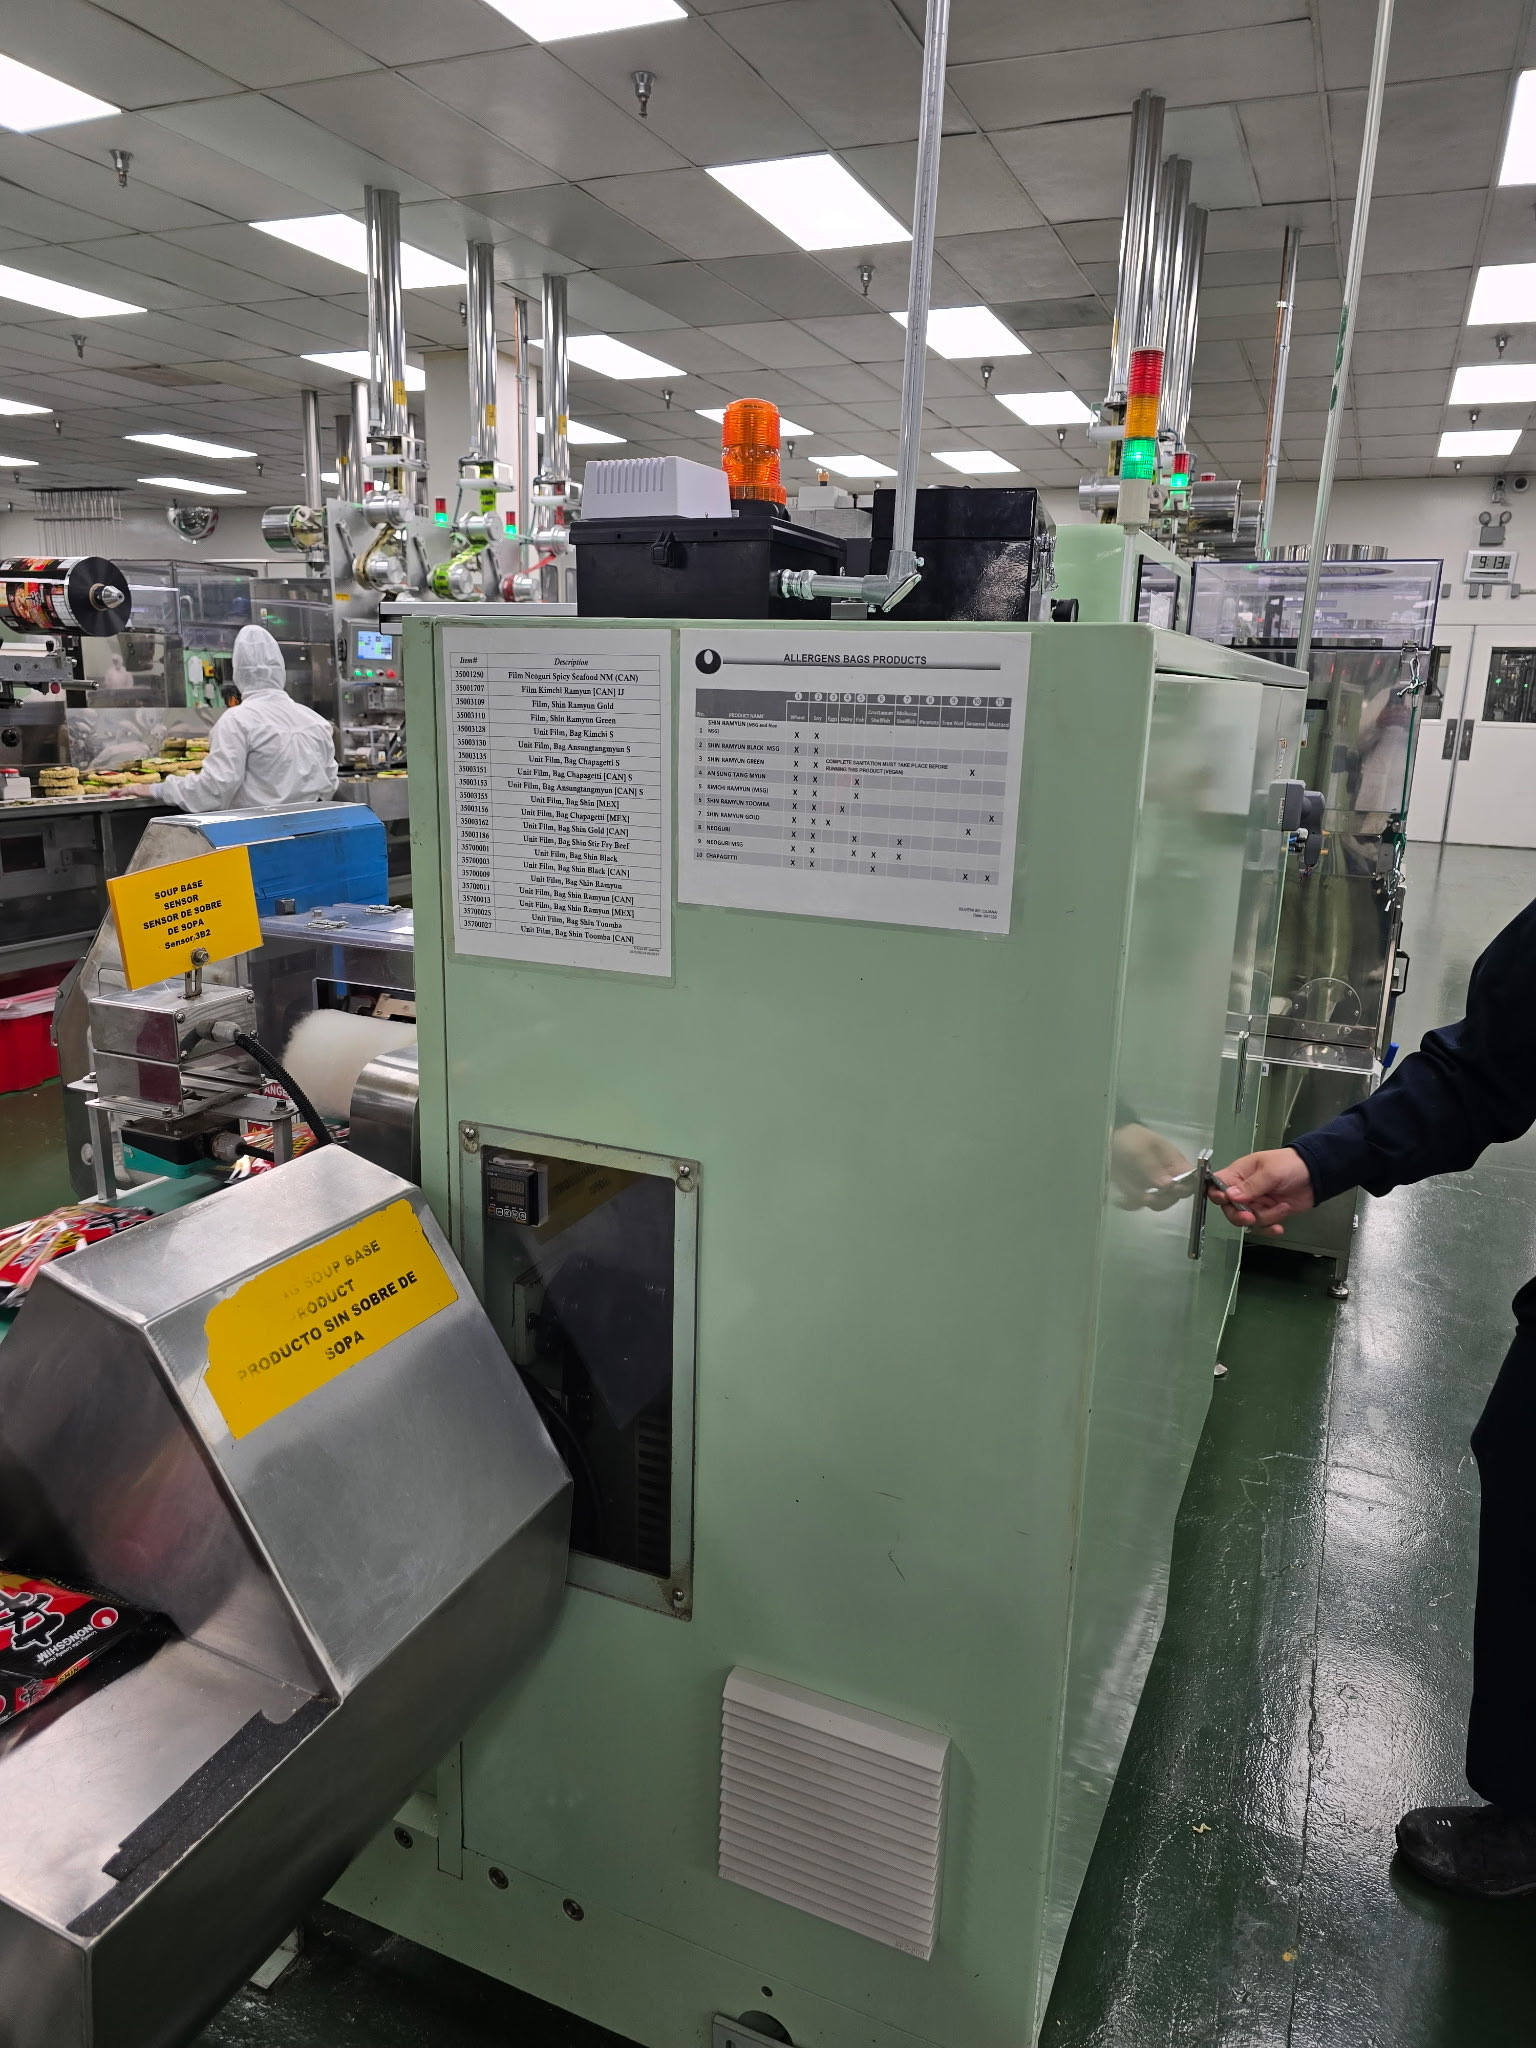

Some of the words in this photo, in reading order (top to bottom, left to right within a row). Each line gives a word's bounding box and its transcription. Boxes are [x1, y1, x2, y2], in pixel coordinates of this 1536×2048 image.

[1479, 556, 1505, 569] 9:13
[554, 658, 589, 668] Description
[784, 654, 840, 664] ALLERGENS
[843, 655, 870, 664] BAGS
[873, 656, 926, 665] PRODUCTS
[532, 700, 550, 709] Film,
[552, 701, 566, 709] Shin
[568, 701, 595, 710] Ramyun
[597, 702, 614, 710] Gold
[537, 810, 554, 818] Film,
[556, 811, 569, 820] Bag
[523, 835, 538, 843] Unit
[539, 836, 556, 847] Film,
[558, 838, 571, 847] Bag
[572, 839, 587, 847] Shin
[601, 841, 613, 850] Fry
[614, 842, 630, 850] Beef
[534, 849, 549, 857] Unit
[550, 851, 568, 861] Film,
[570, 852, 582, 861] Bag
[584, 853, 598, 861] Shin
[600, 854, 618, 863] Black
[154, 887, 178, 900] SOUP
[180, 880, 203, 892] BASE
[164, 894, 199, 910] SENSOR
[519, 900, 534, 908] Unit
[535, 902, 552, 912] Film,
[554, 903, 566, 913] Bag
[583, 906, 610, 915] Ramyun
[612, 908, 634, 919] [MEX]
[143, 913, 179, 930] SENSOR
[180, 909, 193, 919] DE
[194, 900, 222, 915] SOBRE
[167, 926, 179, 936] DE
[181, 918, 205, 932] SOPA
[195, 929, 211, 940] 3B2
[264, 1085, 289, 1097] ANGE
[344, 1239, 381, 1267] BASE
[290, 1279, 356, 1321] RODUCT
[237, 1327, 323, 1382] PRODUCTO
[323, 1310, 350, 1334] SIN
[351, 1281, 398, 1317] SOBRE
[398, 1271, 418, 1289] DE
[325, 1330, 365, 1361] SOPA
[37, 1624, 94, 1663] NONGSHIM
